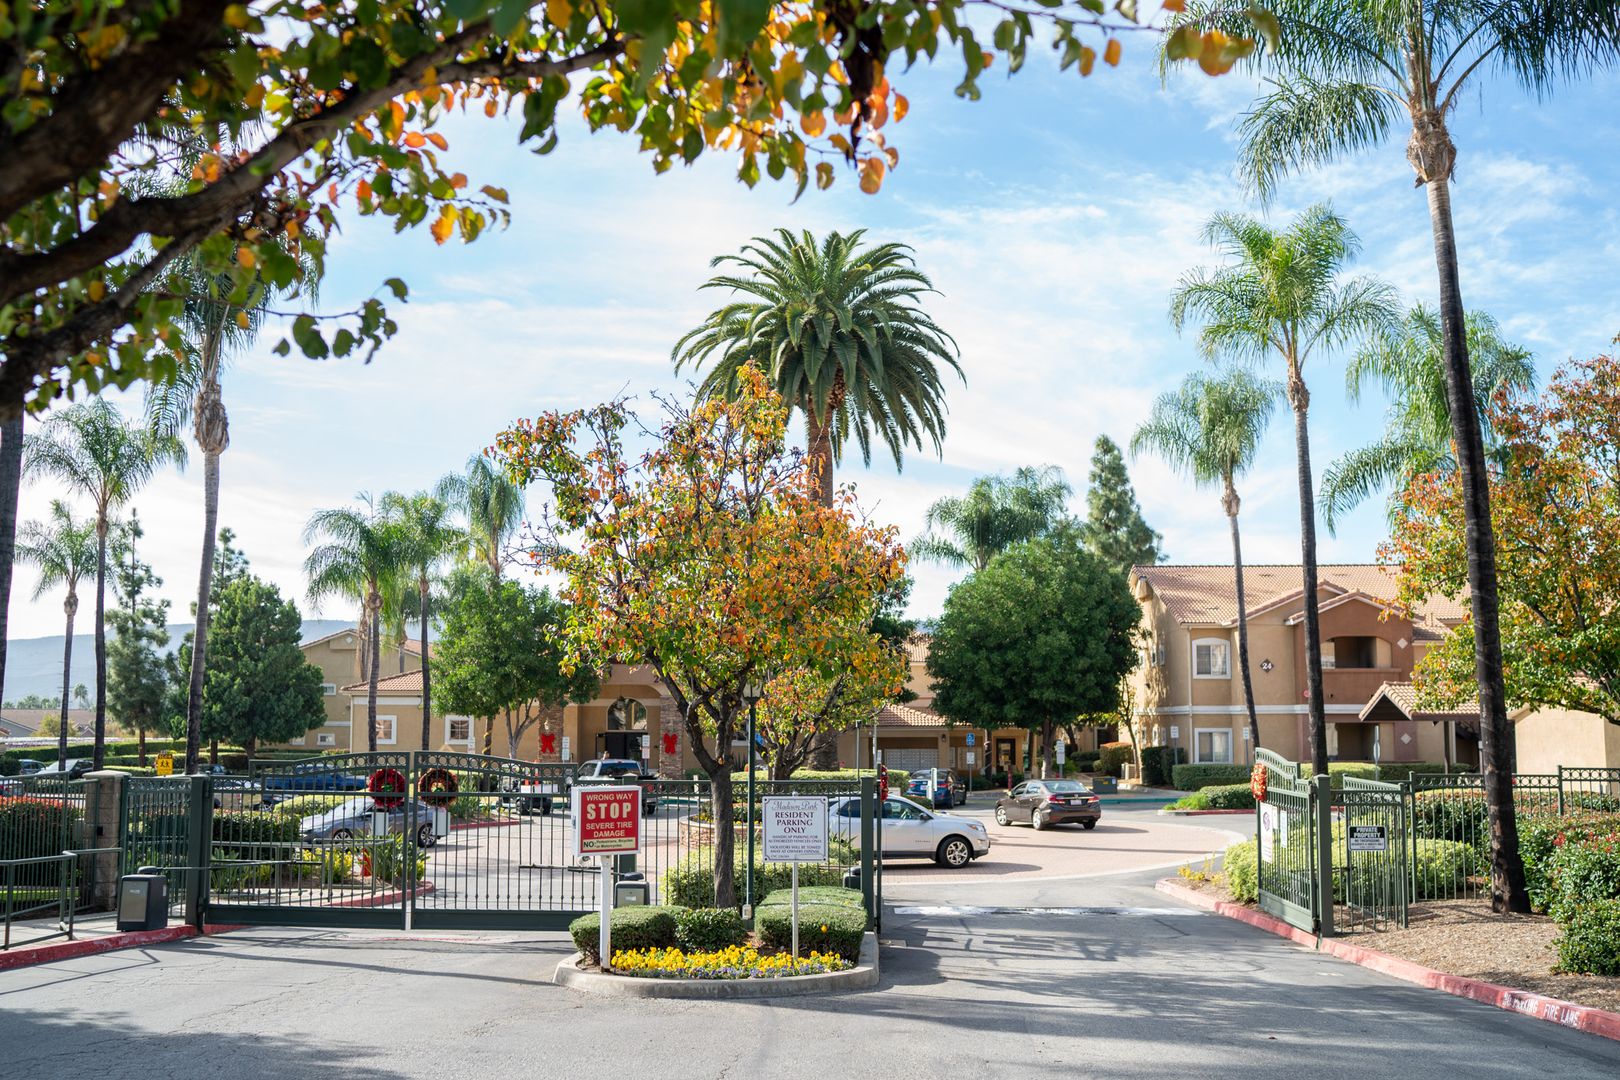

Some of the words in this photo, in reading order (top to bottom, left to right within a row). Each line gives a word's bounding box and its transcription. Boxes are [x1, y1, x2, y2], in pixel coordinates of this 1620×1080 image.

[1262, 662, 1272, 670] 24
[586, 802, 632, 820] STOP
[1543, 1004, 1560, 1020] FIRE
